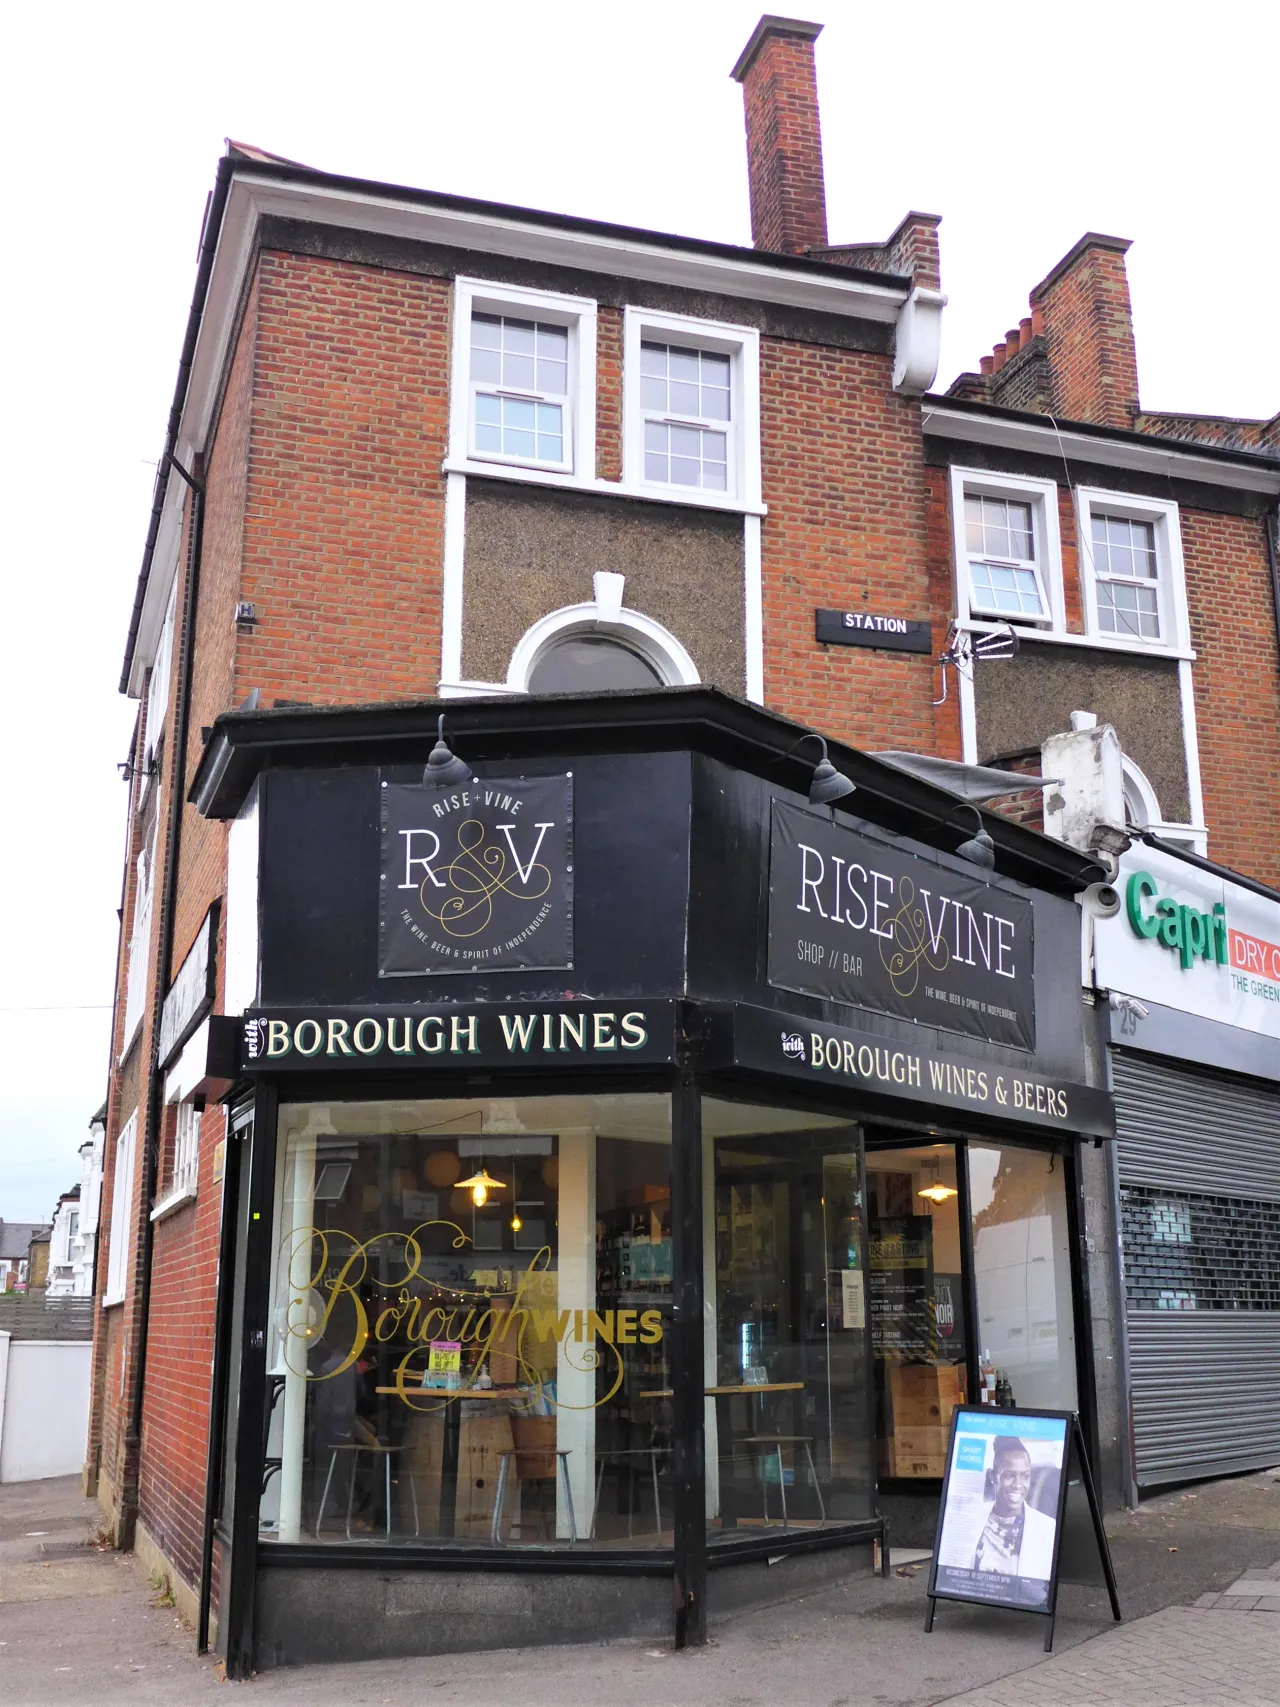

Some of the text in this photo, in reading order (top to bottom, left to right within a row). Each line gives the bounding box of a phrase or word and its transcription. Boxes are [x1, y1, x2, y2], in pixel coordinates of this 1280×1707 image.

[845, 613, 907, 634] STATION
[432, 791, 471, 818] RISE
[485, 791, 523, 815] VINE
[797, 843, 893, 940] RISE
[920, 889, 1016, 979] VINE
[1126, 870, 1229, 970] Capri
[400, 909, 413, 925] THE
[431, 941, 451, 956] BEER
[453, 950, 459, 958] &
[462, 949, 489, 959] SPIRIT
[493, 945, 503, 956] OF
[505, 902, 553, 951] INDEPENDENCE
[798, 939, 824, 965] SHOP
[843, 953, 863, 977] BAR
[1234, 935, 1268, 973] DRY
[1231, 973, 1249, 993] THE
[925, 986, 935, 998] THE
[949, 992, 961, 1006] BEER
[966, 998, 980, 1011] SPIRIT
[981, 1002, 987, 1012] OF
[987, 1004, 1018, 1021] INDEPENDENCE
[1120, 1006, 1137, 1037] 29
[244, 1012, 649, 1058] with BOROUGH WINES
[781, 1033, 1068, 1118] with BOROUGH WINES & BEERS
[533, 1309, 663, 1344] WINES
[946, 1568, 970, 1578] WEDNESDAY
[976, 1573, 1000, 1583] SEPTEMBER
